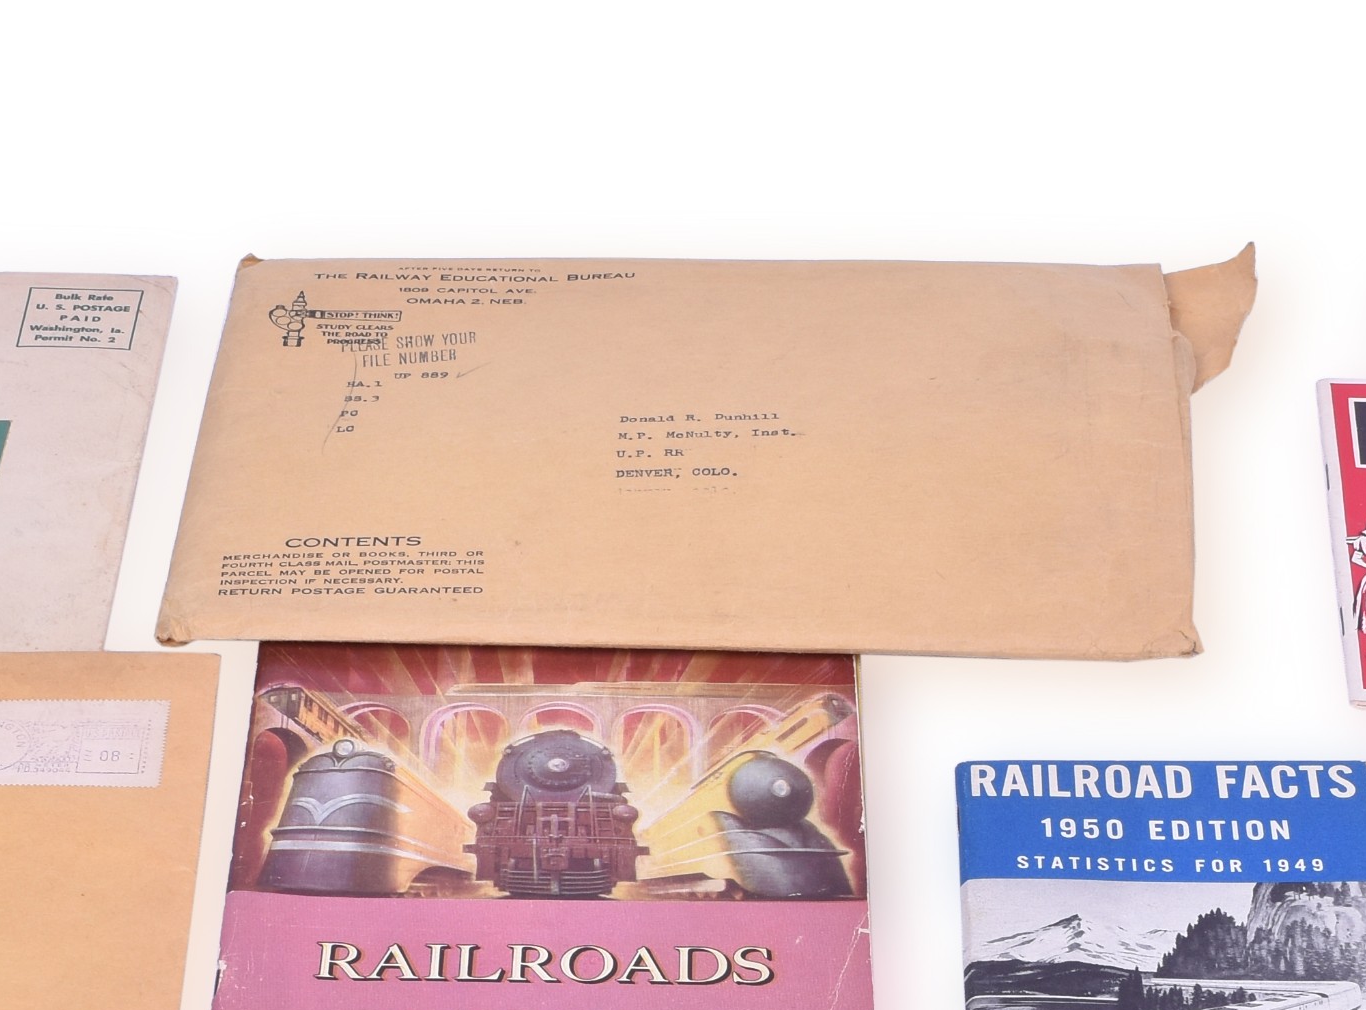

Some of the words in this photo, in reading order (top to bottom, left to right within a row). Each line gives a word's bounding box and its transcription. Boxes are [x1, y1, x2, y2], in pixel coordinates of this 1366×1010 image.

[325, 310, 359, 319] STOP!
[396, 335, 435, 348] SHOW
[441, 332, 476, 345] YOUR
[363, 353, 390, 367] FILE
[399, 349, 456, 364] NUMBER
[615, 468, 682, 479] DENVER,
[691, 468, 738, 476] COLO.
[284, 537, 422, 548] CONTENTS
[970, 764, 1192, 799] RAILROAD
[1216, 765, 1355, 798] FACTS
[1041, 818, 1123, 839] 1950
[1149, 820, 1290, 840] EDITION
[1017, 856, 1173, 872] STATISTICS
[1194, 859, 1243, 872] FOR
[1262, 859, 1324, 872] 1949
[313, 941, 775, 986] RAILROADS
